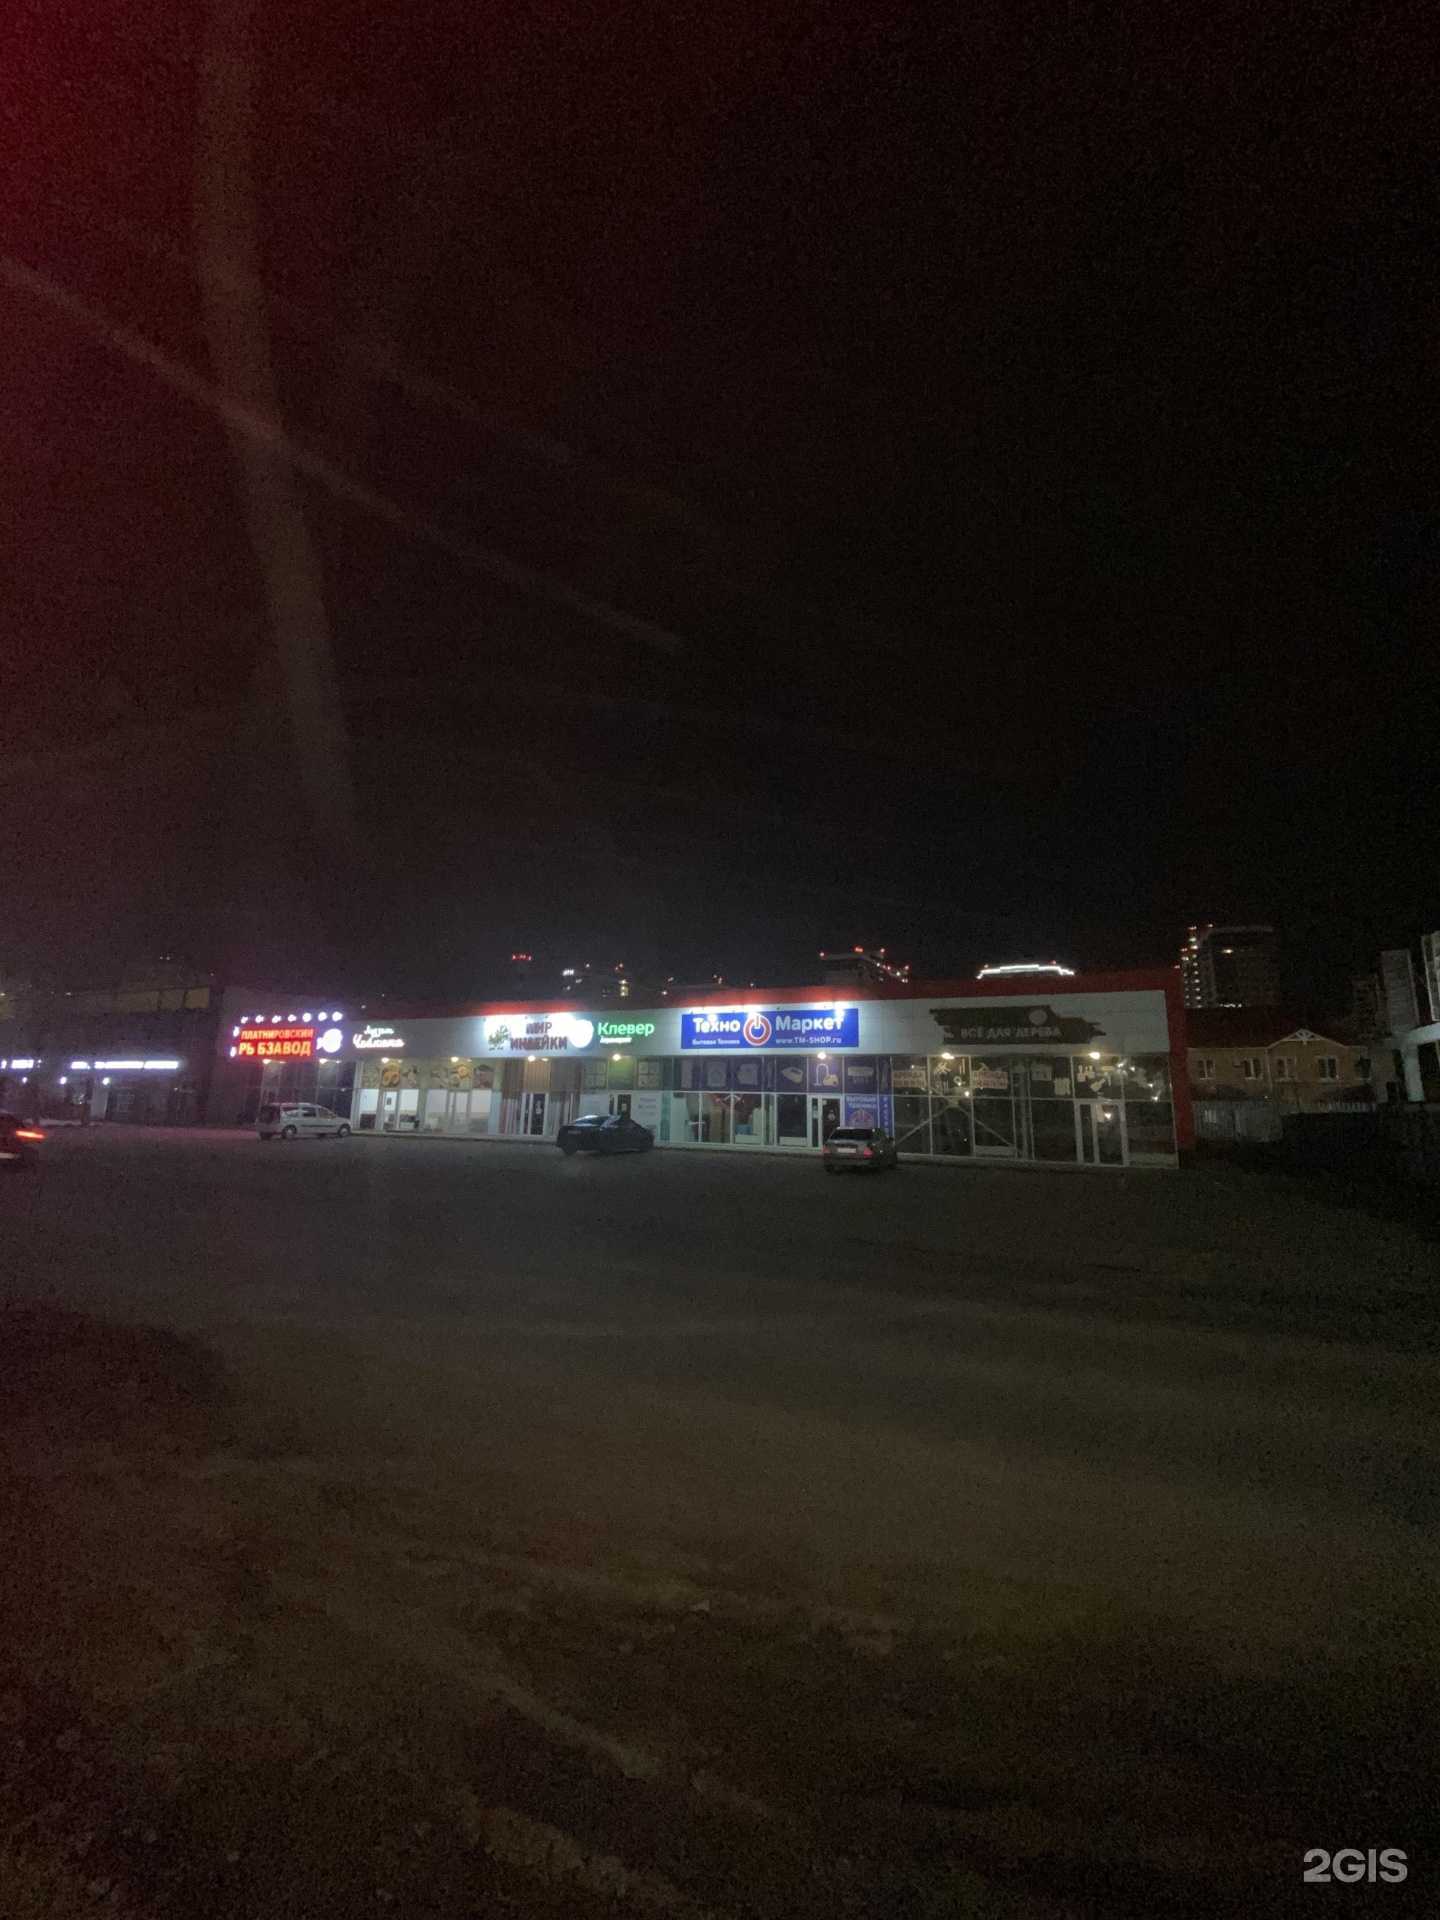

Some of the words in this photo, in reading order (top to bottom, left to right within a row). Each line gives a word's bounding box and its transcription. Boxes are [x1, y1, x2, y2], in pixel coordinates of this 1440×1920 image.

[526, 1022, 552, 1034] МИР
[598, 1022, 655, 1036] Клевер
[693, 1017, 741, 1033] Техно
[776, 1015, 843, 1033] Маркет
[986, 1027, 1011, 1039] ДЛЯ
[1015, 1026, 1062, 1038] ДЕРЕВА
